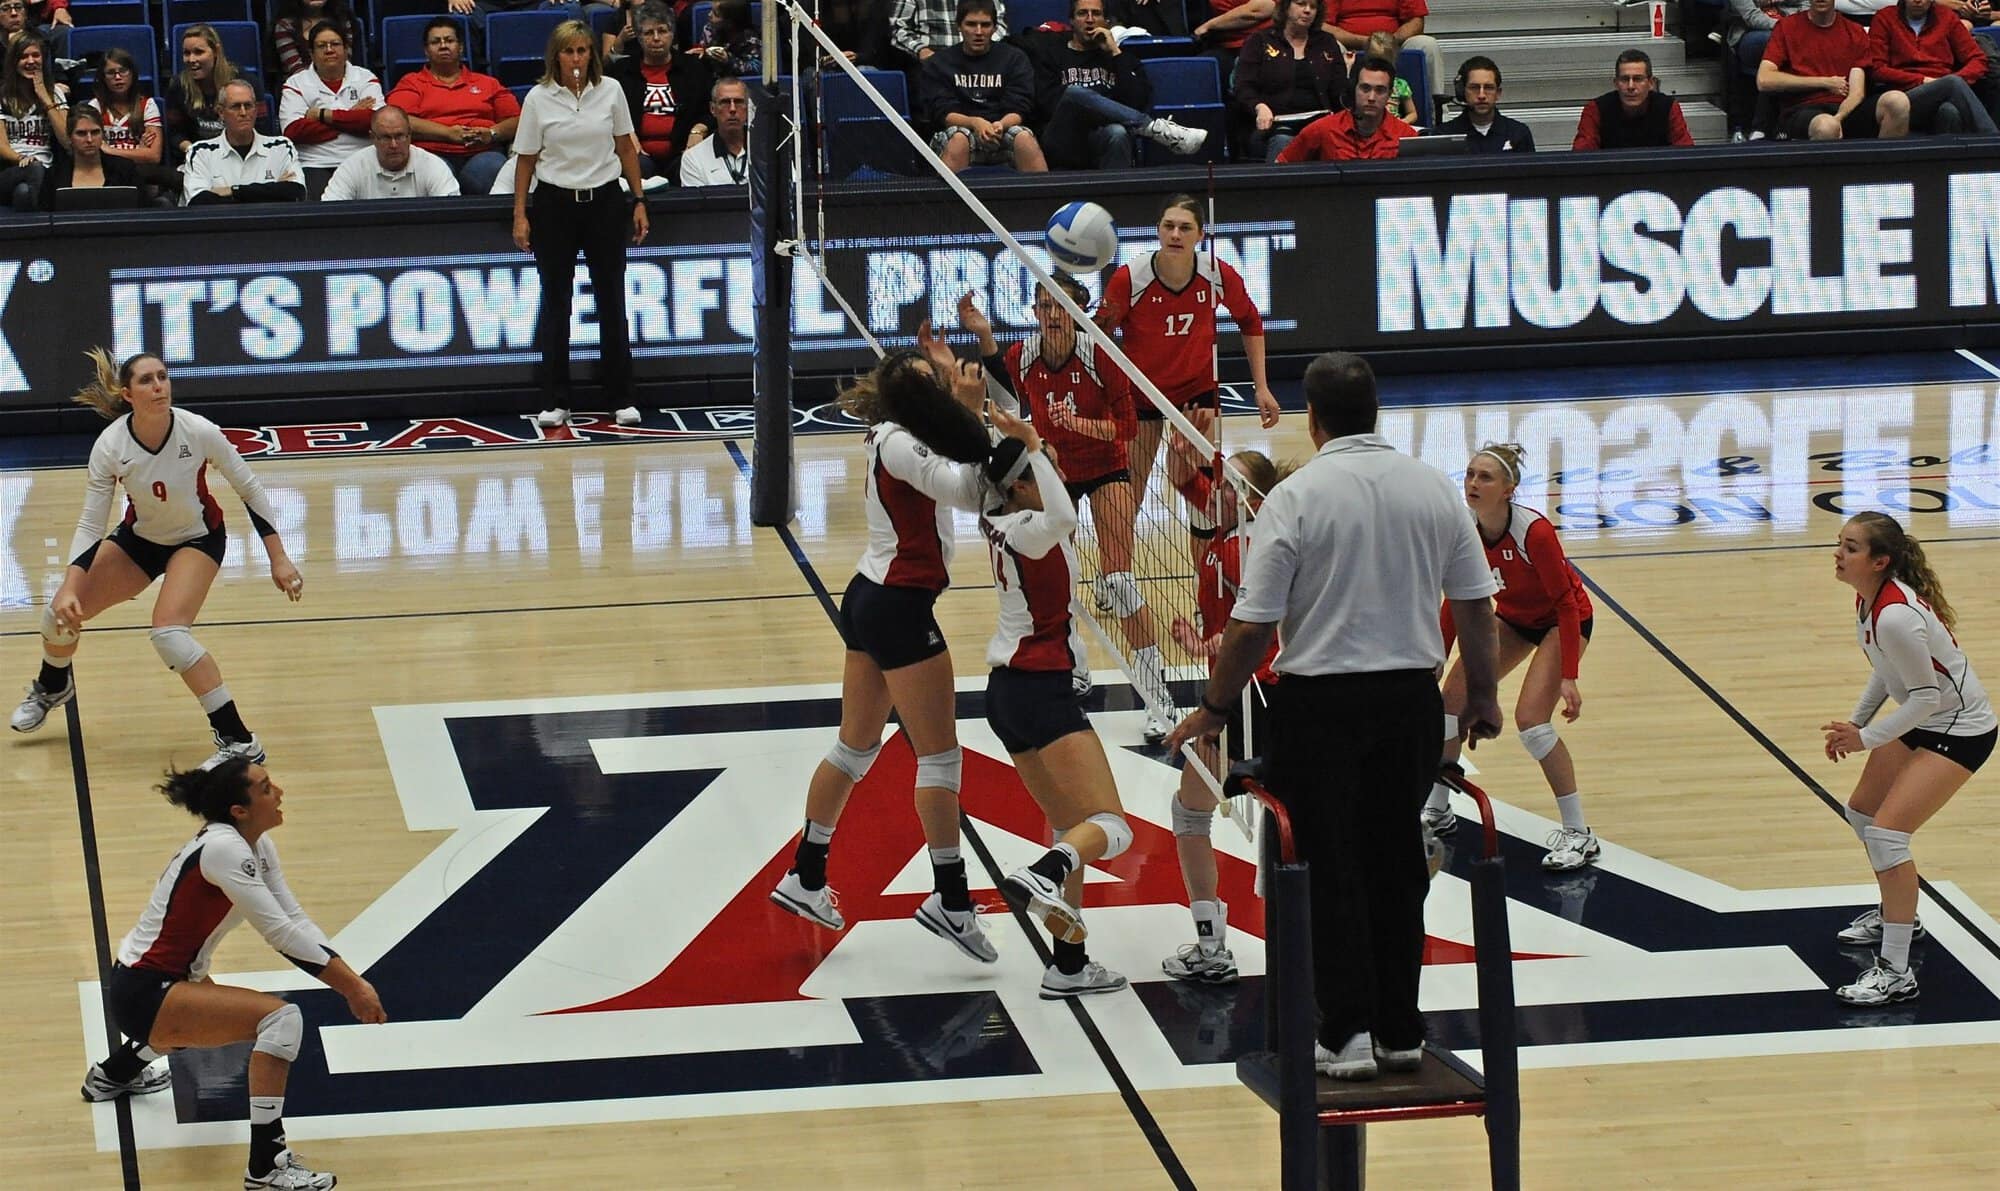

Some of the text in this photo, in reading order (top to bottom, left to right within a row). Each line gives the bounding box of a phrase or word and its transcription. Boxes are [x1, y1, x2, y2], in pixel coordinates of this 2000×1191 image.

[954, 73, 1002, 88] ARIZONA
[1375, 183, 1917, 332] MUSCLE
[110, 275, 304, 363] IT'S
[1165, 313, 1195, 337] 17
[151, 480, 168, 502] 9
